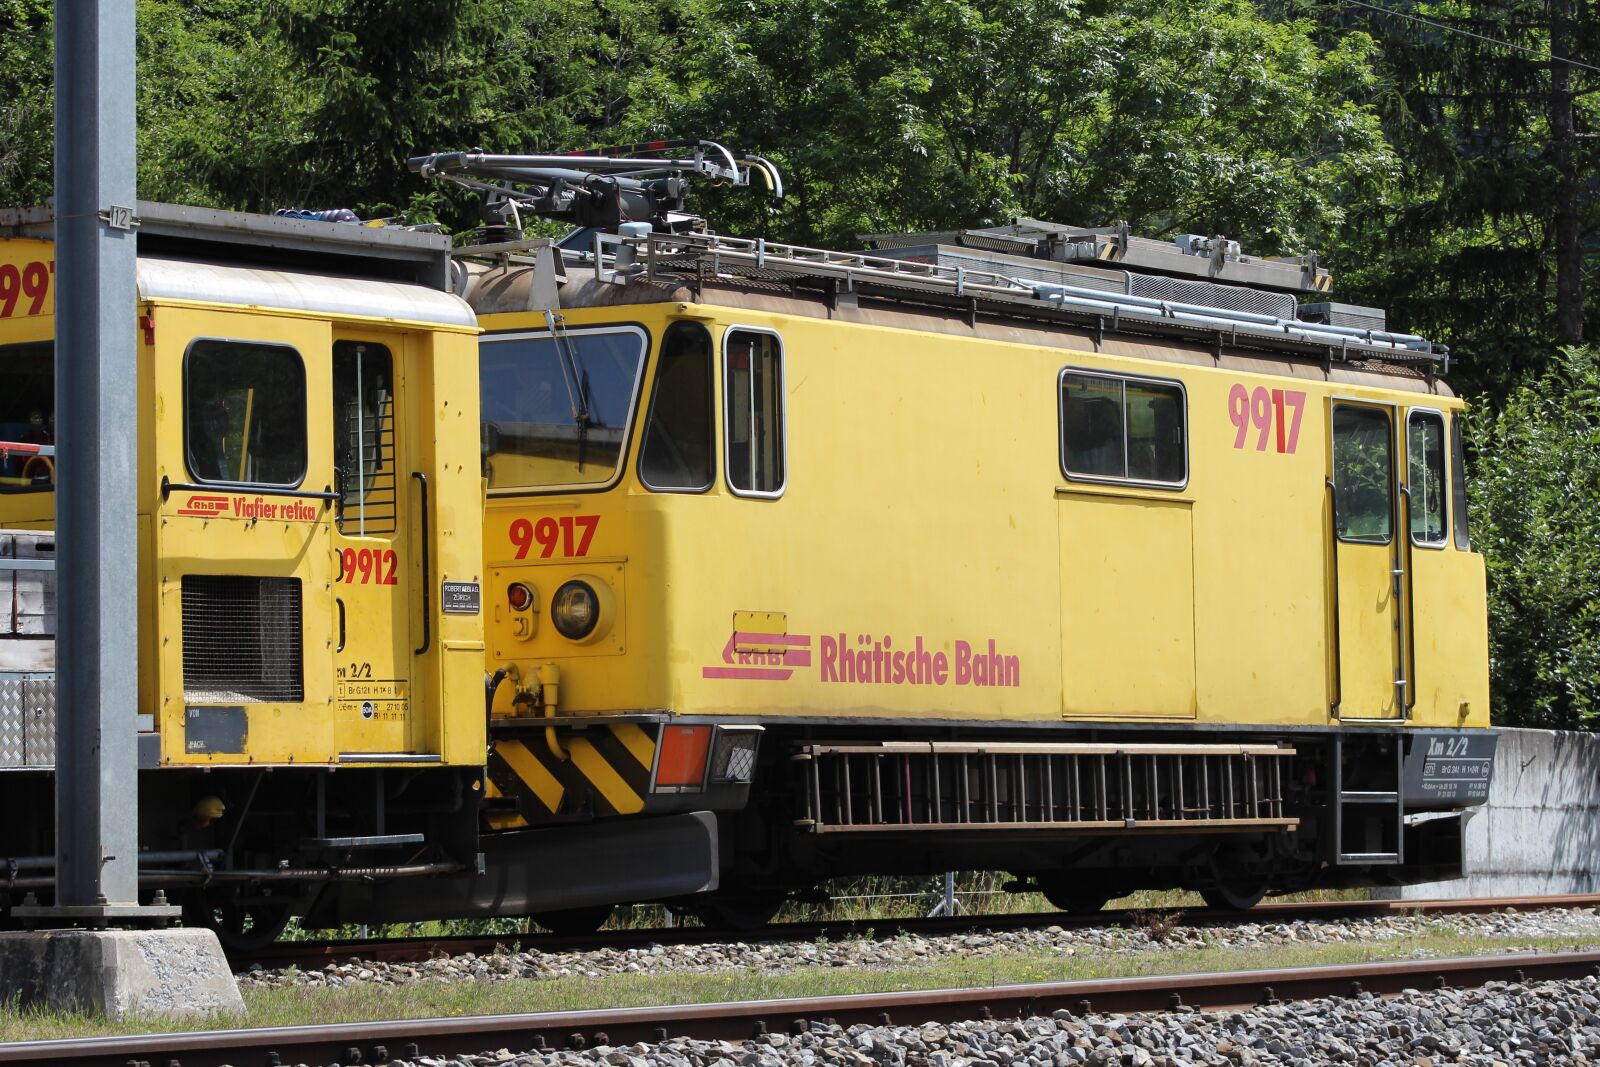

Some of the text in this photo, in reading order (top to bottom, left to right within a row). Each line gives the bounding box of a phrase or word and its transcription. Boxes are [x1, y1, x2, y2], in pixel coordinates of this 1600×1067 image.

[1228, 383, 1306, 454] 9917
[233, 497, 316, 521] Viafier retica
[509, 515, 600, 560] 9917
[342, 547, 398, 585] 9912
[351, 662, 371, 678] 2/2
[821, 633, 1020, 687] Rhätische Bahn
[1428, 737, 1469, 757] Xm 2/2
